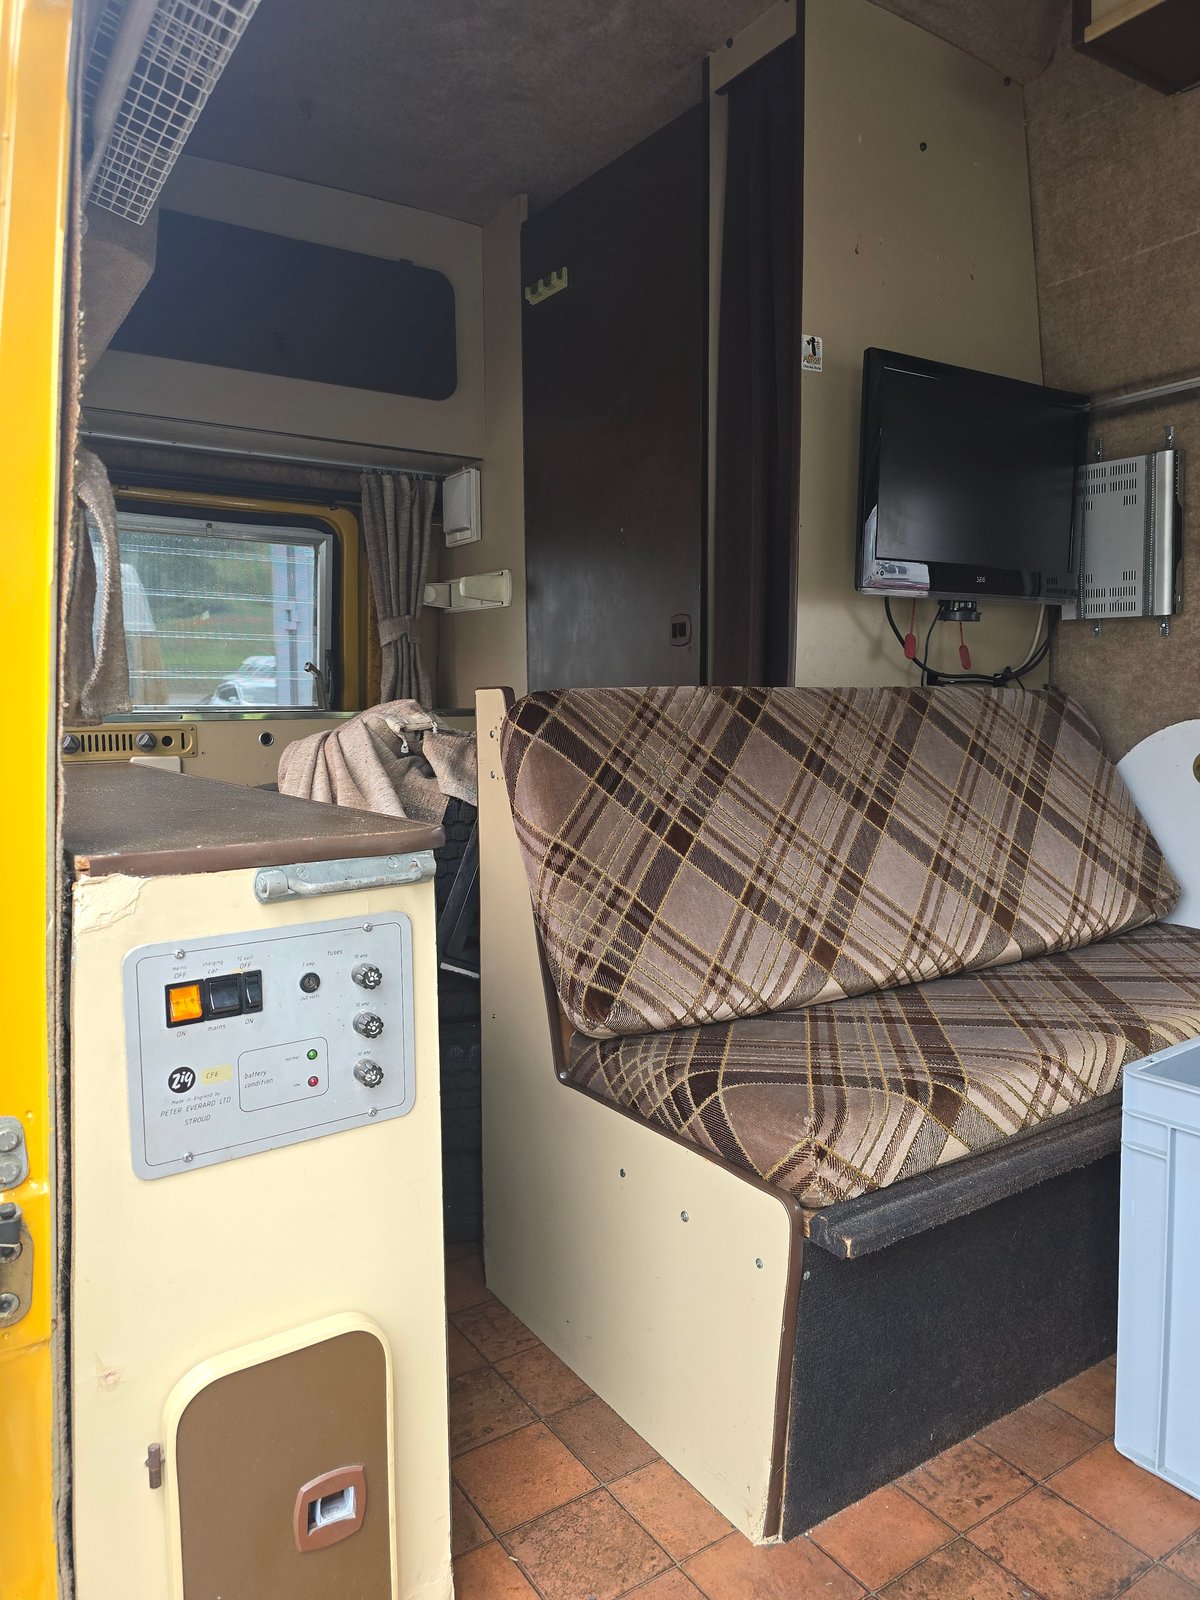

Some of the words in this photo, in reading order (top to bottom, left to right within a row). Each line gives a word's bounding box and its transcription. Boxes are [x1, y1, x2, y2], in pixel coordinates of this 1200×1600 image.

[176, 1030, 187, 1038] ON
[244, 1070, 267, 1079] battery
[171, 1071, 194, 1090] Zig
[244, 1078, 274, 1089] condition
[193, 1093, 213, 1101] England
[160, 1107, 183, 1117] PETER
[185, 1100, 216, 1112] EVERARD
[219, 1096, 232, 1105] LTD
[184, 1114, 211, 1126] STROUD
